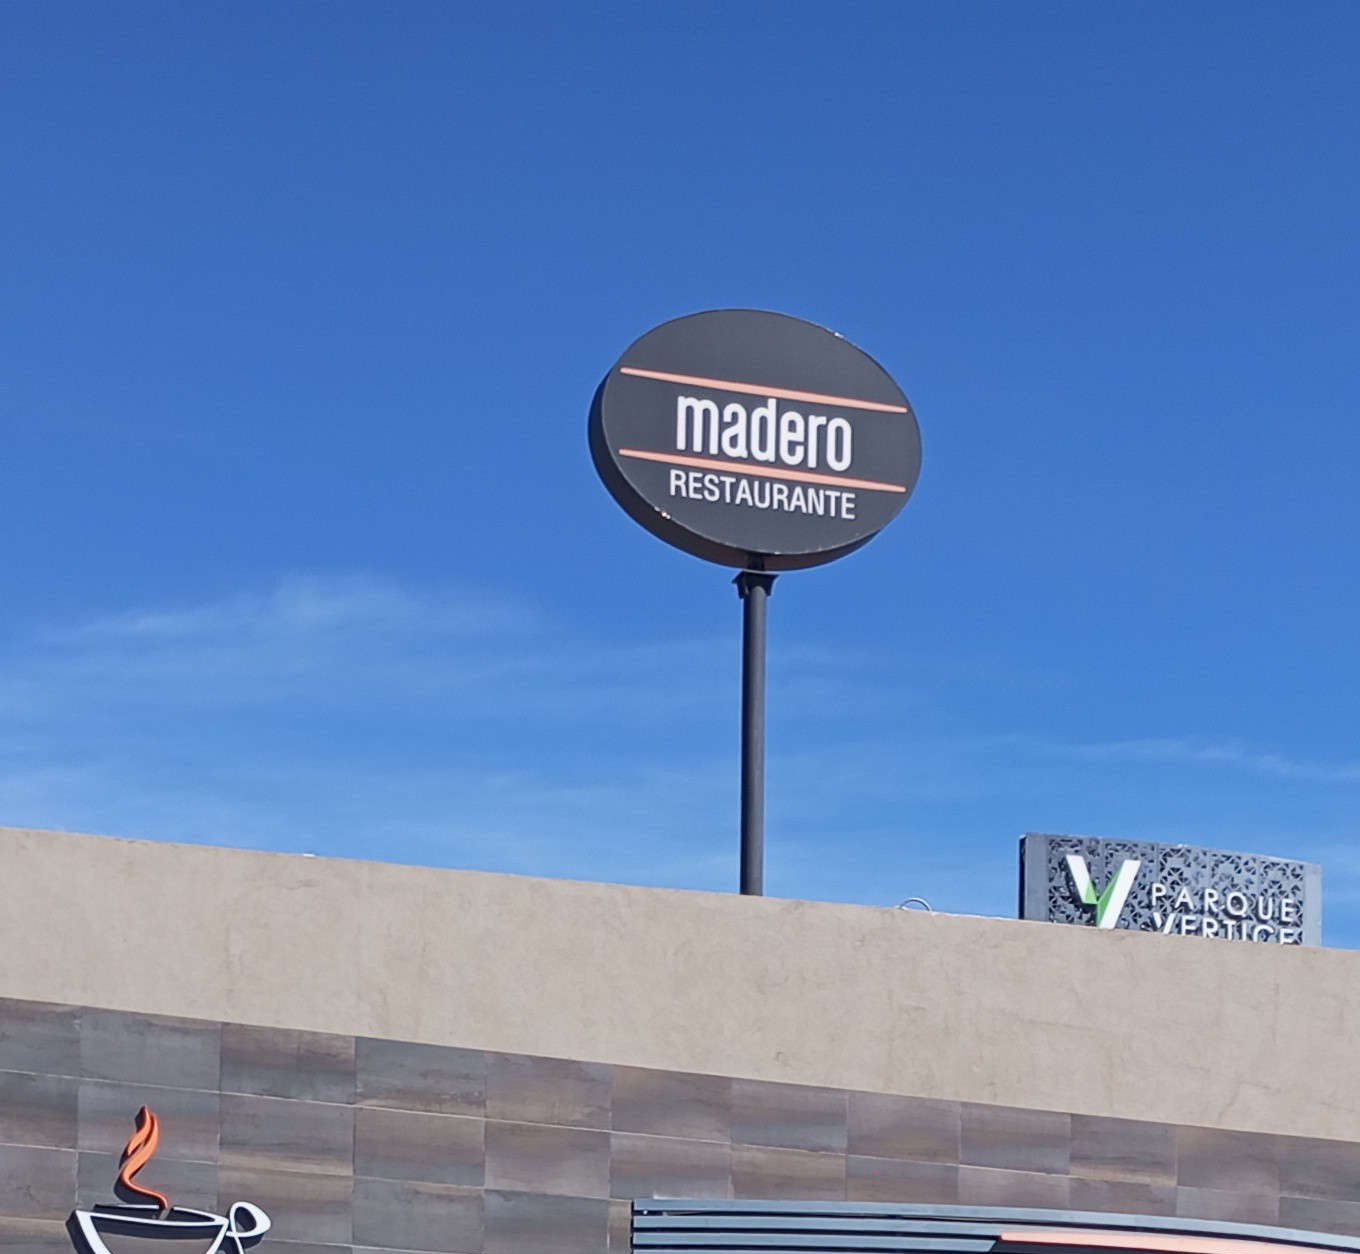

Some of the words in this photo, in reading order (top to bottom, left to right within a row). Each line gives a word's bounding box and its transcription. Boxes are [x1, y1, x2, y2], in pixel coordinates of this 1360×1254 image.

[676, 395, 853, 472] madero
[669, 469, 856, 520] RESTAURANTE
[1151, 882, 1294, 922] PARQUE
